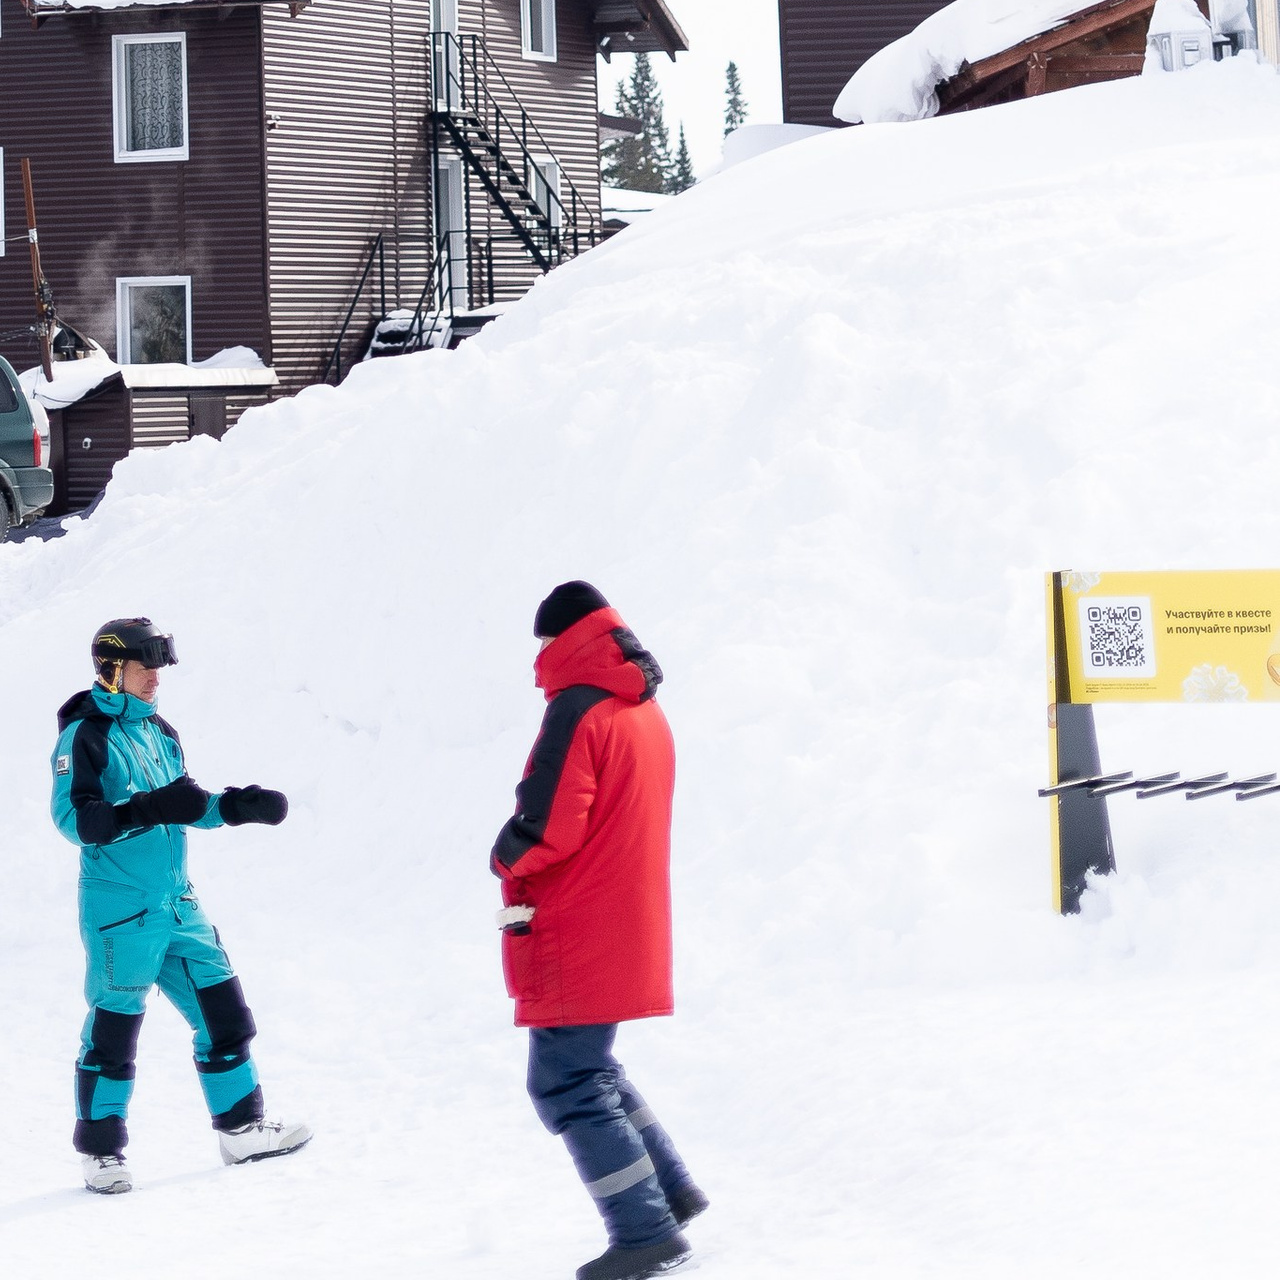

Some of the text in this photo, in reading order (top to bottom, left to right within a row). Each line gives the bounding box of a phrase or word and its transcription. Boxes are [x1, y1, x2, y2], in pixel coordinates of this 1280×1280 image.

[1165, 609, 1271, 620] Участвуйте в квесте
[1166, 624, 1271, 635] и получайте призы!
